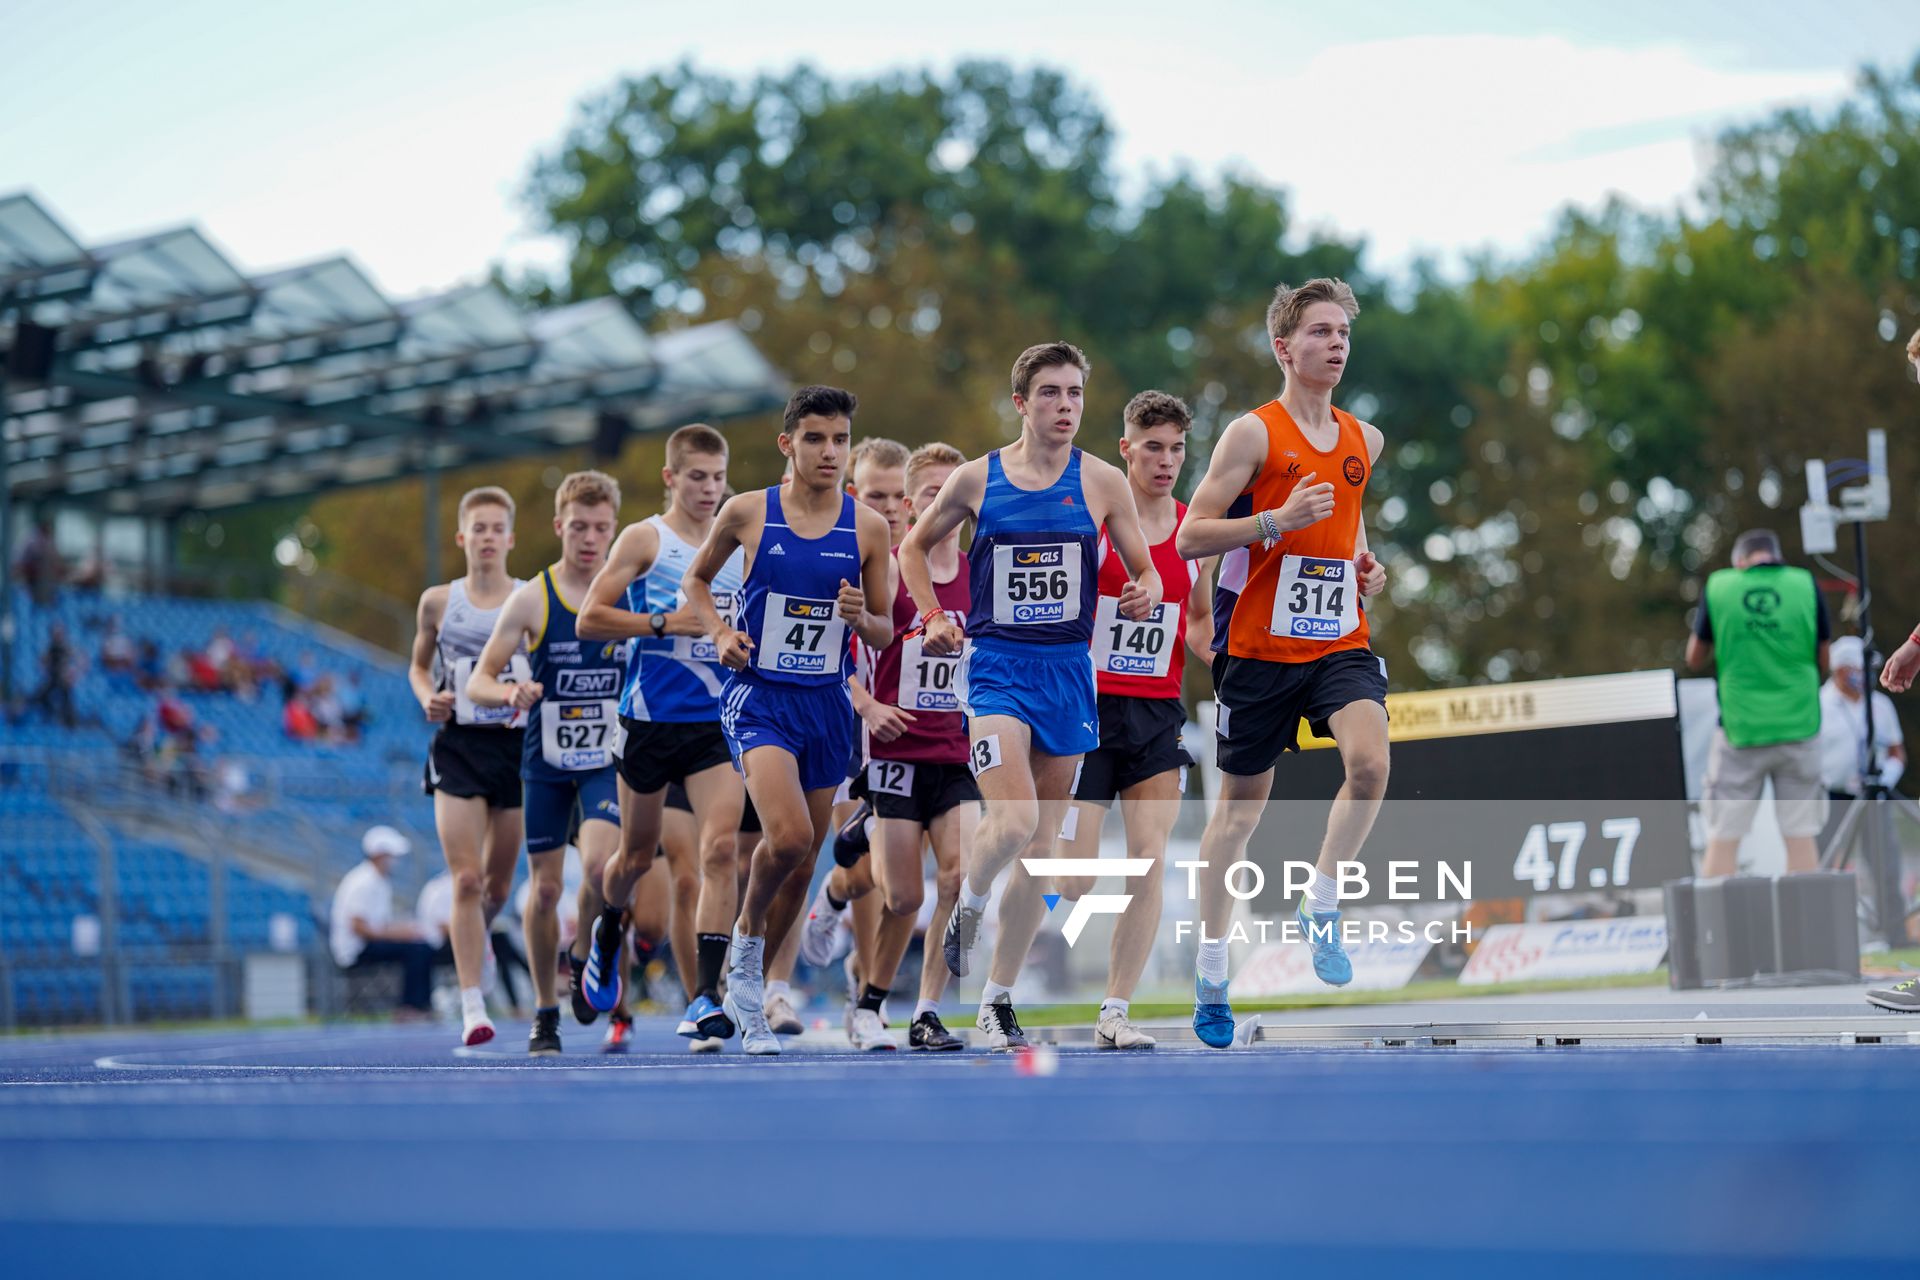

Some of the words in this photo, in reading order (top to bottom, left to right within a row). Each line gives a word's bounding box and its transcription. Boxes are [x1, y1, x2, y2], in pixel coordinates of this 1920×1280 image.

[1040, 551, 1059, 563] GLS
[1324, 566, 1342, 578] GLS
[1008, 570, 1068, 602] 556
[810, 606, 831, 617] GLS
[1034, 605, 1062, 616] PLAN
[1288, 582, 1344, 617] 314
[785, 623, 826, 651] 47
[1110, 623, 1165, 654] 140
[1312, 621, 1338, 632] PLAN
[798, 656, 824, 666] PLAN
[1128, 659, 1154, 668] PLAN
[916, 661, 957, 689] 10
[557, 724, 607, 749] 627
[877, 762, 906, 791] 12
[1513, 817, 1641, 891] 47.7
